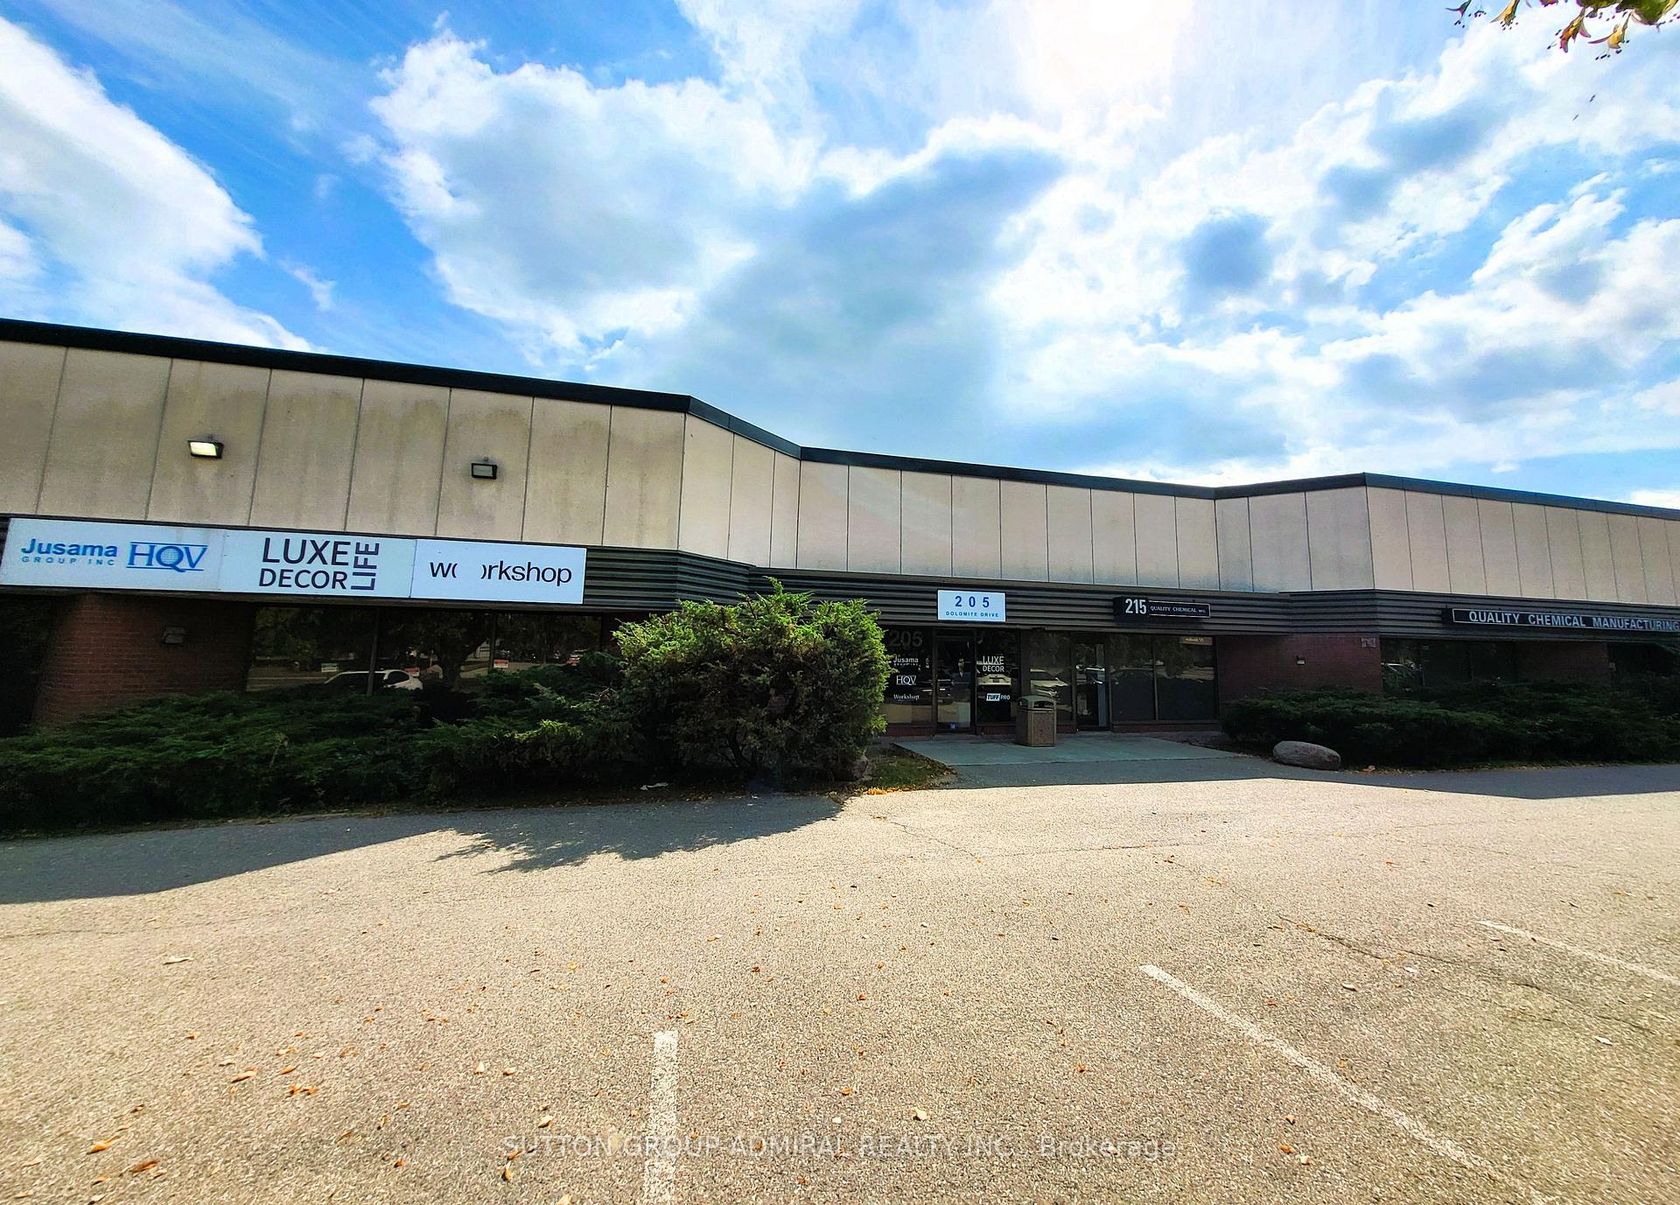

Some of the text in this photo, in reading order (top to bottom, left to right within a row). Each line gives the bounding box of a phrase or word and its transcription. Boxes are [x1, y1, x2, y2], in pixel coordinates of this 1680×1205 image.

[21, 538, 118, 558] Jusama
[126, 541, 208, 572] HQV
[262, 537, 351, 566] LUXE
[22, 556, 115, 566] GROUP INC
[351, 541, 380, 590] LIFE
[259, 568, 348, 589] DECOR
[1125, 598, 1147, 614] 215
[1469, 611, 1680, 631] QUALITY CHEMICAL MANUFACTURING
[982, 655, 1005, 665] LUXE
[896, 675, 917, 686] HQV
